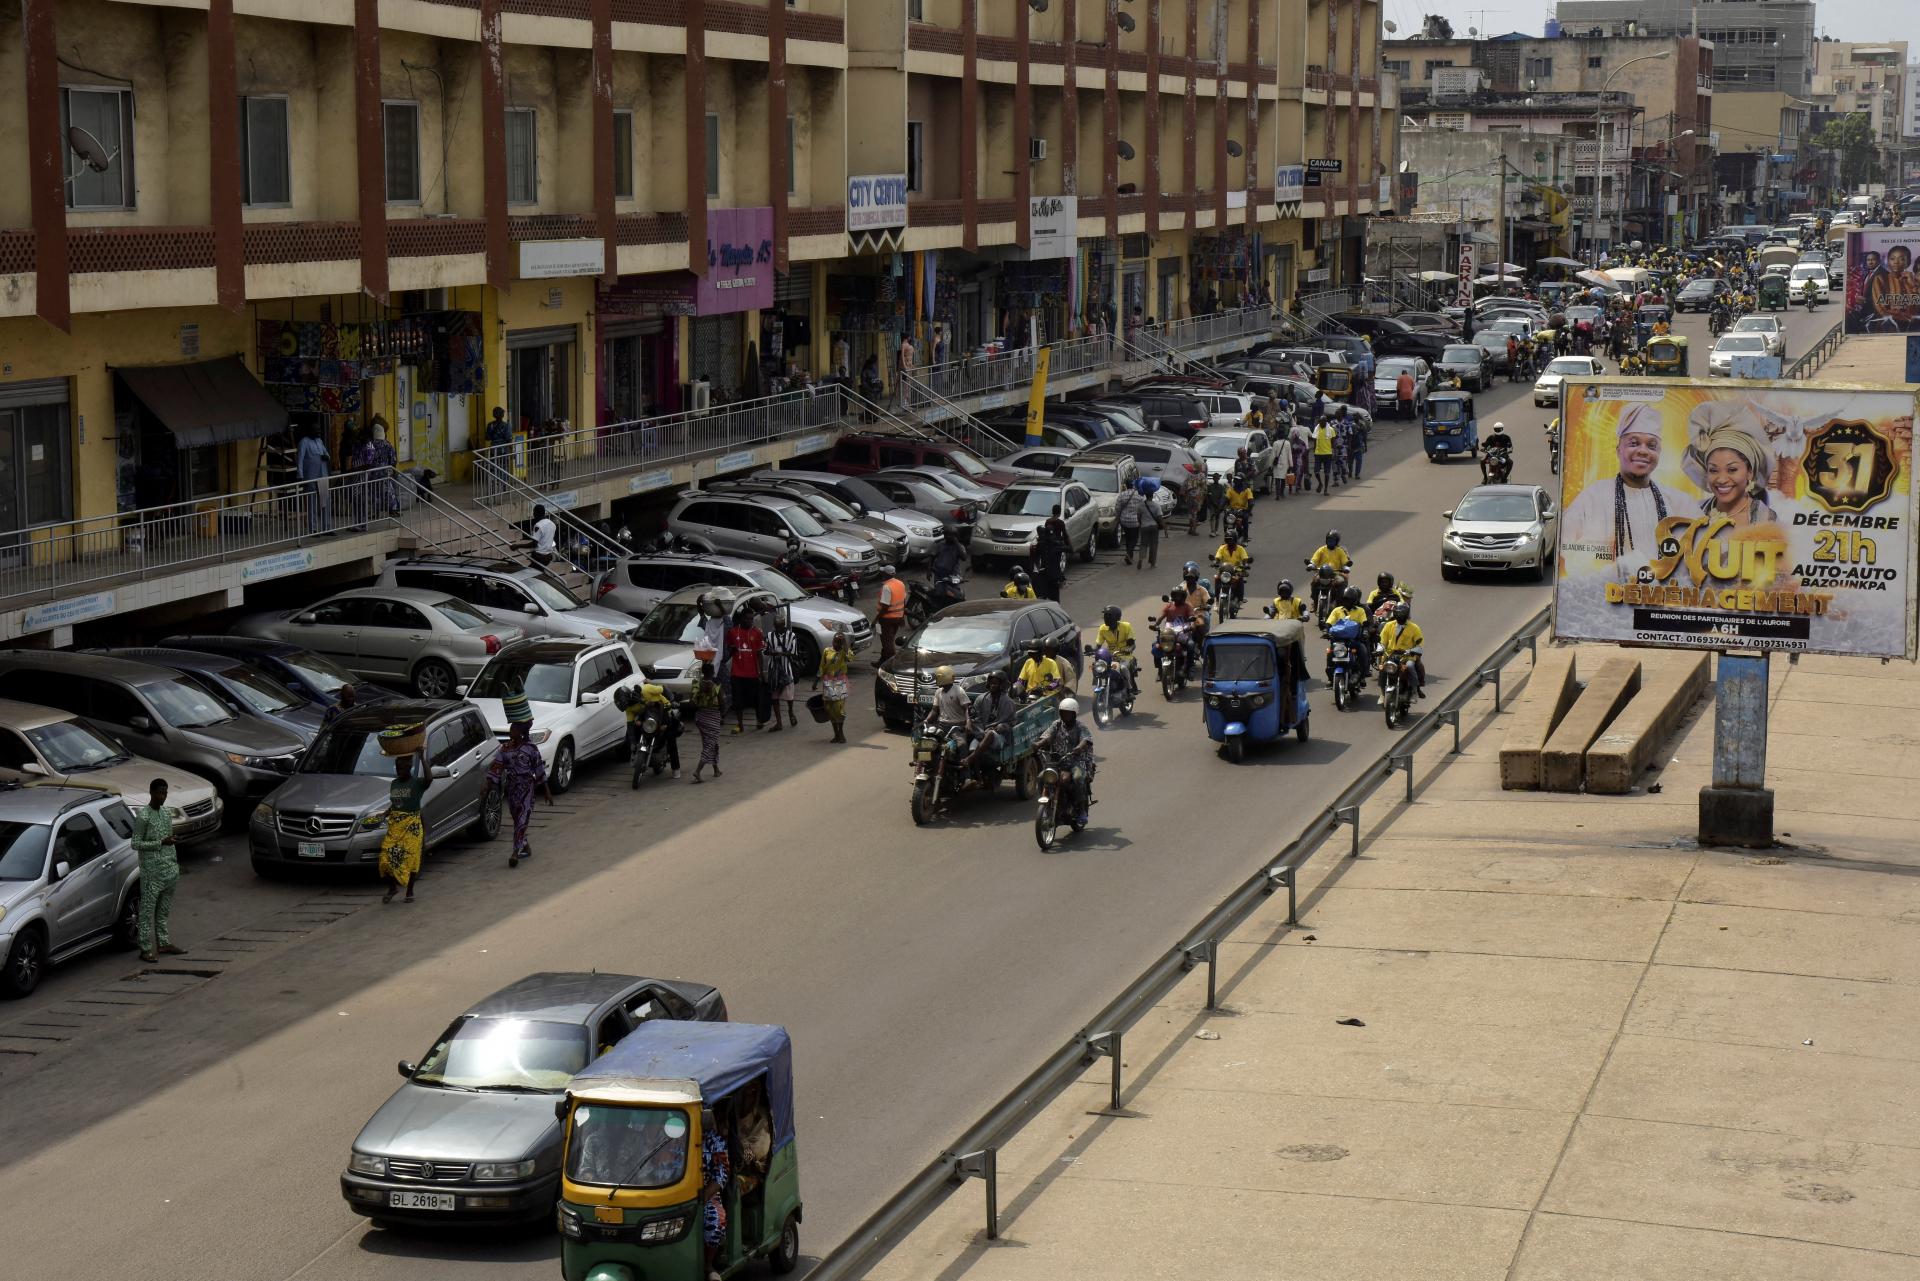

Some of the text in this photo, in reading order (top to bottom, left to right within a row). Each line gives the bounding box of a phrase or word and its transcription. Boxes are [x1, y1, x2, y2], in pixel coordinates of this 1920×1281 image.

[850, 178, 906, 207] CITY CENTRE
[1459, 245, 1472, 307] PARKING
[1818, 442, 1876, 493] 31
[1792, 511, 1899, 529] DÉCEMBRE
[1663, 543, 1677, 553] LA
[1813, 530, 1876, 564] 21h
[1638, 571, 1653, 580] DE
[1791, 564, 1896, 580] AUTO-AUTO
[1801, 578, 1887, 591] BAZOUNKPA
[1605, 576, 1834, 615] DÉMÉNAGEMENT
[1650, 613, 1680, 621] REUNION
[1698, 615, 1744, 624] PARTENAIRES
[1758, 618, 1791, 626] L'AURORE
[1711, 624, 1739, 634] À 6H
[1636, 632, 1683, 642] CONTACT:
[1686, 635, 1744, 646] 0169374444
[1754, 639, 1807, 648] 0197314931
[393, 1194, 408, 1206] BL
[413, 1195, 438, 1207] 2618
